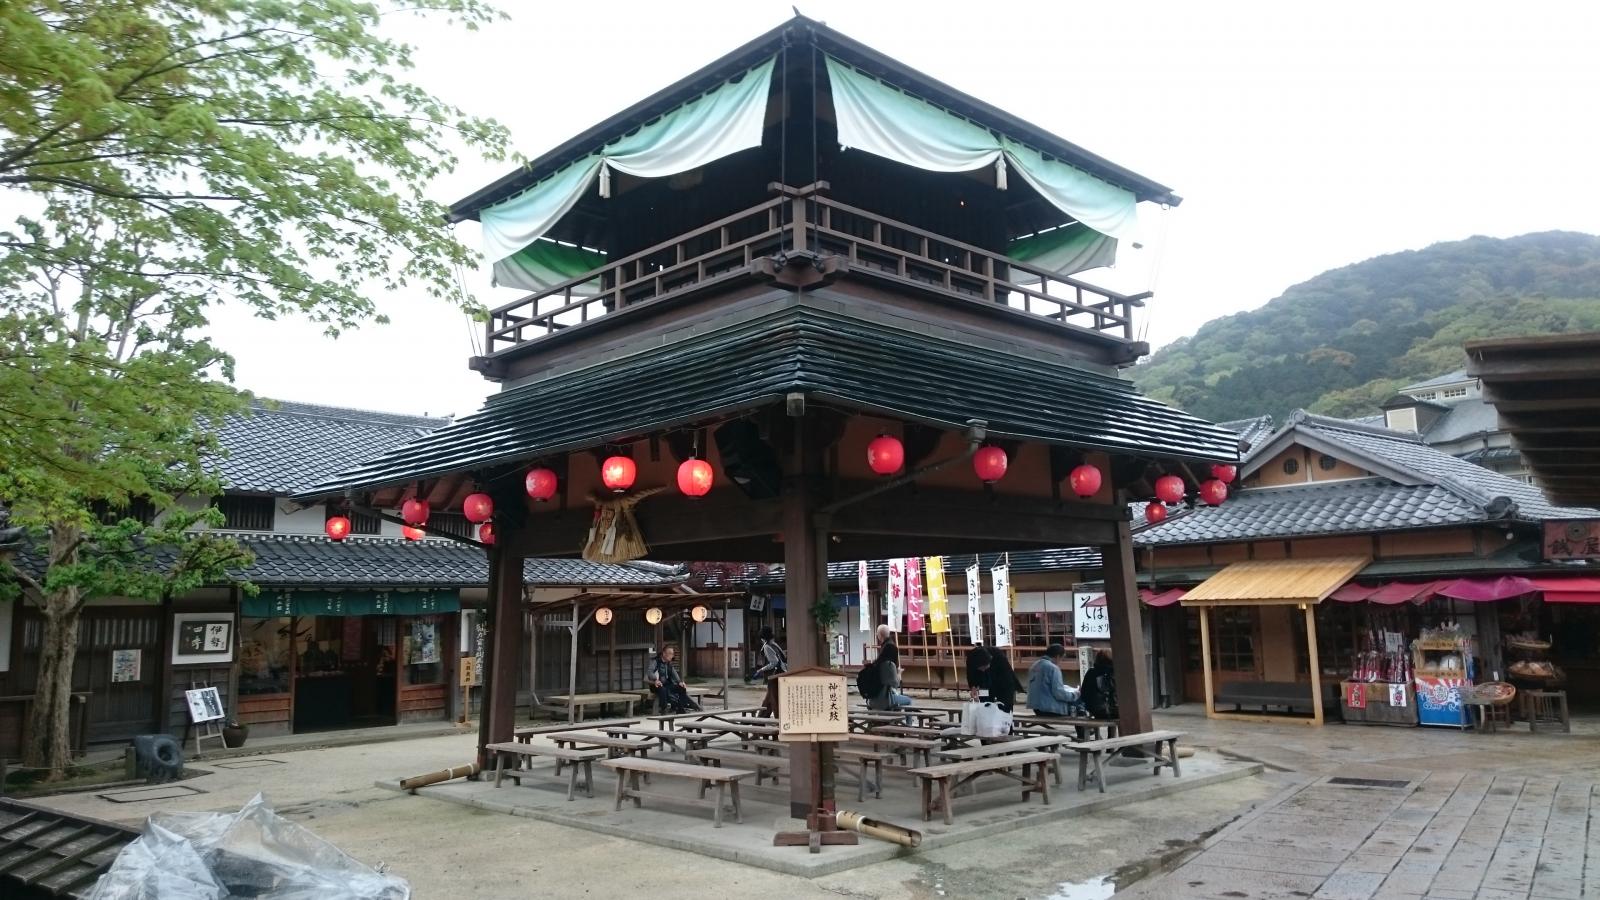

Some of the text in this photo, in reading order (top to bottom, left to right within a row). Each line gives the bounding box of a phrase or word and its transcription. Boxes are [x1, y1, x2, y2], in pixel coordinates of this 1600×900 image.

[1080, 595, 1104, 620] そば
[1080, 621, 1109, 633] おにぎり
